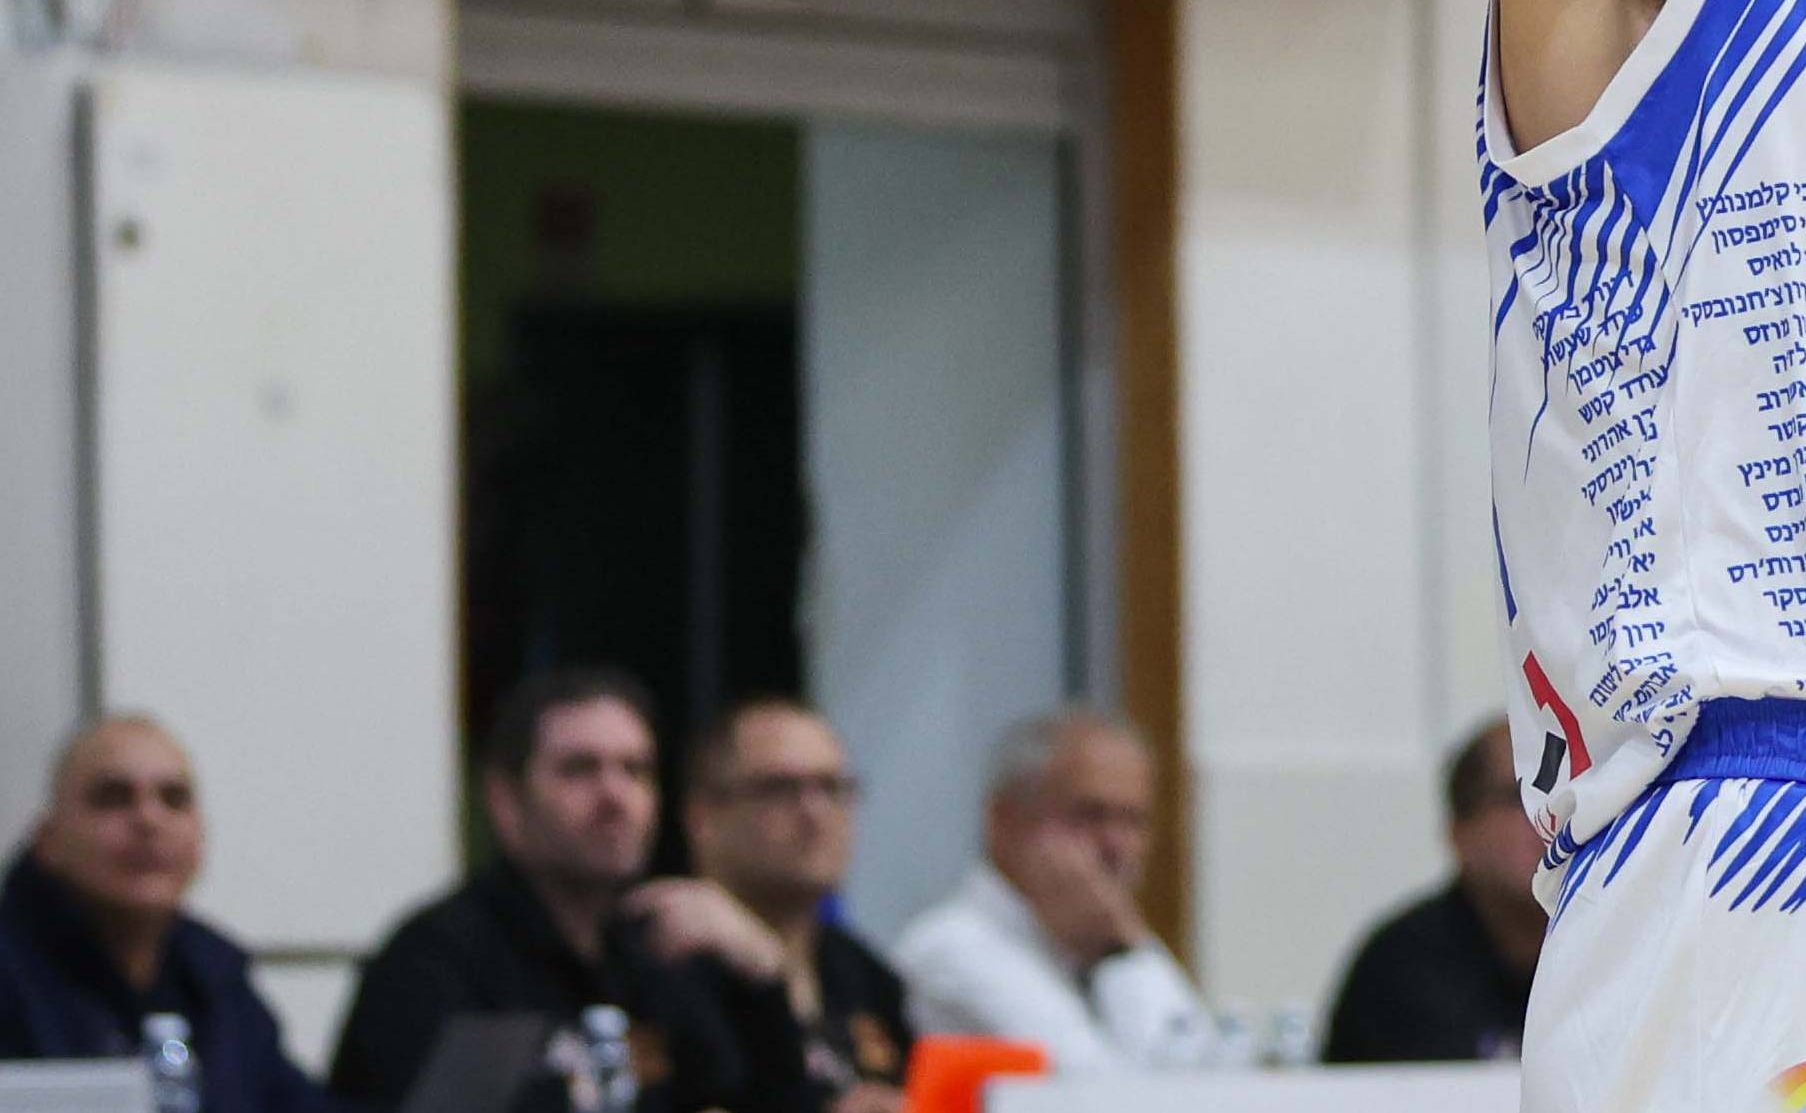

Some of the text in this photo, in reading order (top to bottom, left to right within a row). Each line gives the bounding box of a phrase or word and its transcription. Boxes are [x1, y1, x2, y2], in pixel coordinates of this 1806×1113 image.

[1711, 214, 1797, 254] סימפסון
[1746, 241, 1802, 276] לואיס
[1618, 364, 1669, 400] עודד
[1578, 389, 1615, 425] קטש
[1736, 455, 1793, 488] מינץ
[1621, 620, 1666, 649] ירון
